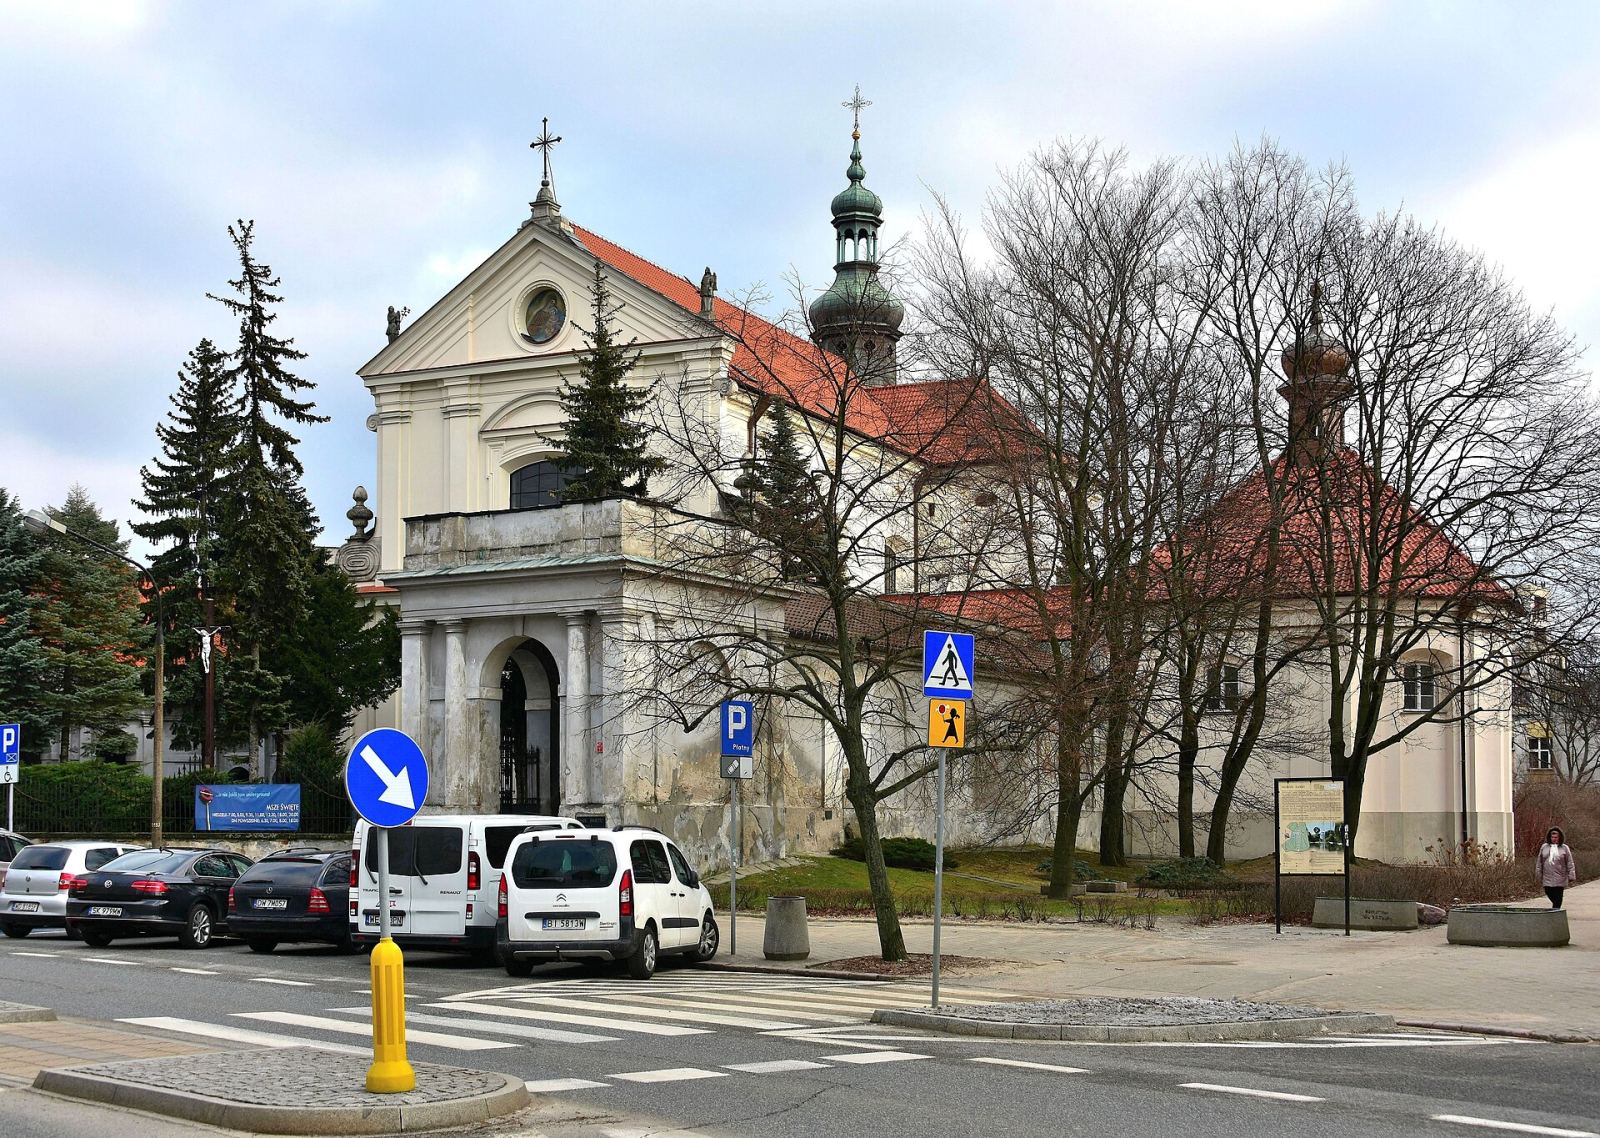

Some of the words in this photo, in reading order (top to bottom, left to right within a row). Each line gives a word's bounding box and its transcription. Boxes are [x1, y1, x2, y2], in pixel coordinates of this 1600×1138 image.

[728, 705, 747, 739] P
[3, 728, 15, 753] P
[266, 803, 279, 811] MSZE
[280, 802, 299, 811] ŚWIĘTE
[547, 919, 557, 928] BI
[560, 919, 585, 928] 5813W
